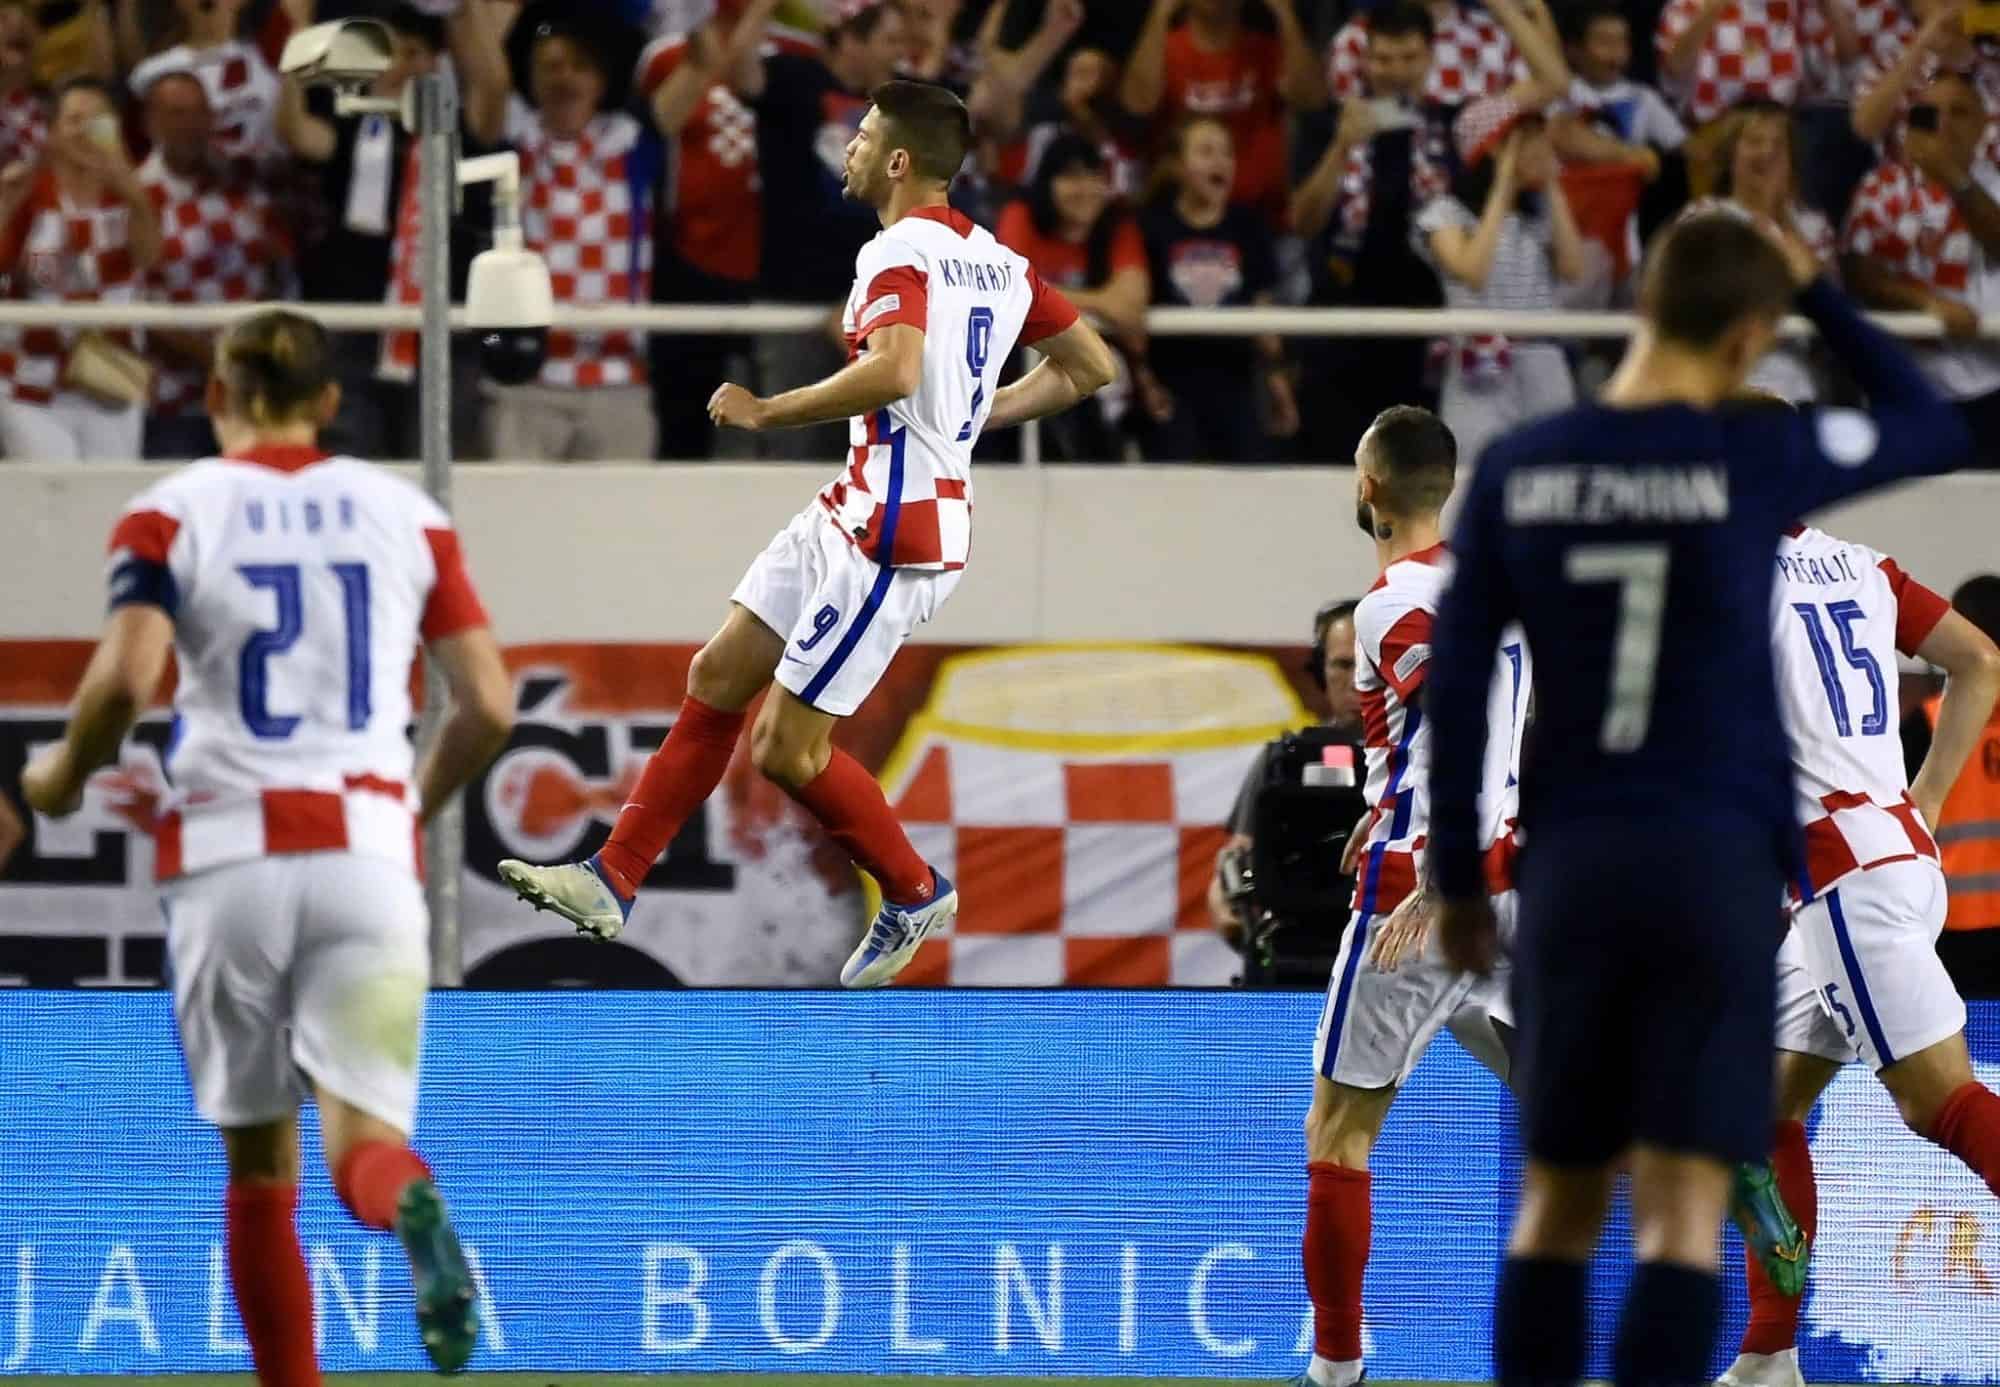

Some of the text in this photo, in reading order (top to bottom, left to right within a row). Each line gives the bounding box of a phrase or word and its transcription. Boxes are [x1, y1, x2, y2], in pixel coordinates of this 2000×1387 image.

[957, 306, 994, 441] 9
[235, 561, 371, 738] 21
[797, 603, 840, 652] 9
[1566, 546, 1668, 750] 7
[1791, 600, 1889, 737] 15
